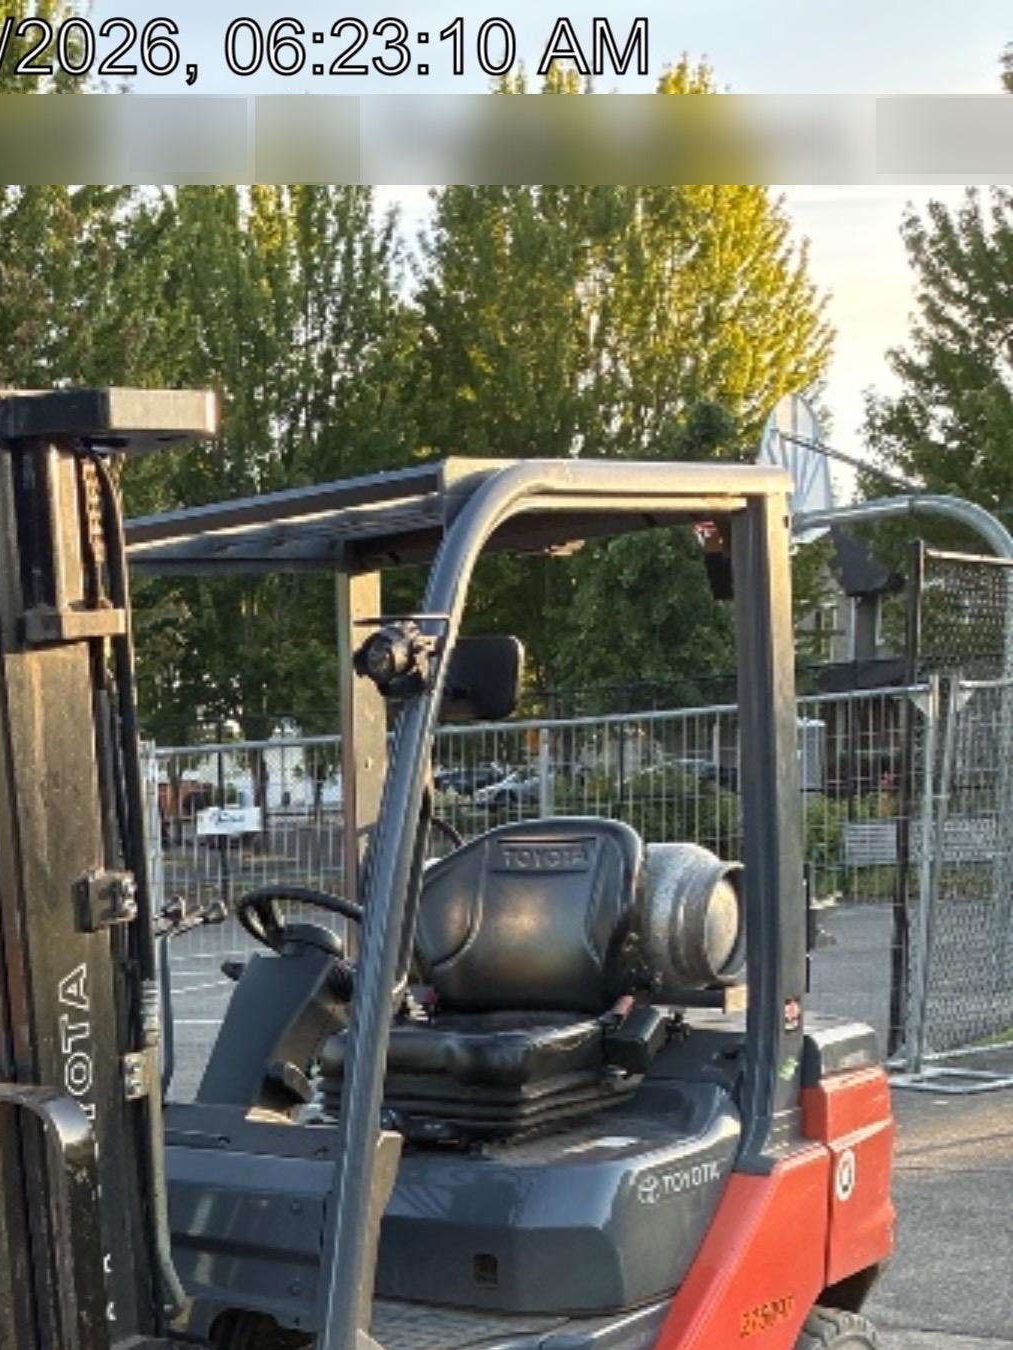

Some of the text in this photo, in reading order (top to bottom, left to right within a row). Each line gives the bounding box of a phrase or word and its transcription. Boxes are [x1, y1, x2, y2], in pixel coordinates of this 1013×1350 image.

[502, 850, 588, 869] TOYOTA
[58, 962, 96, 1120] OTA
[661, 1160, 720, 1194] TOYOTA
